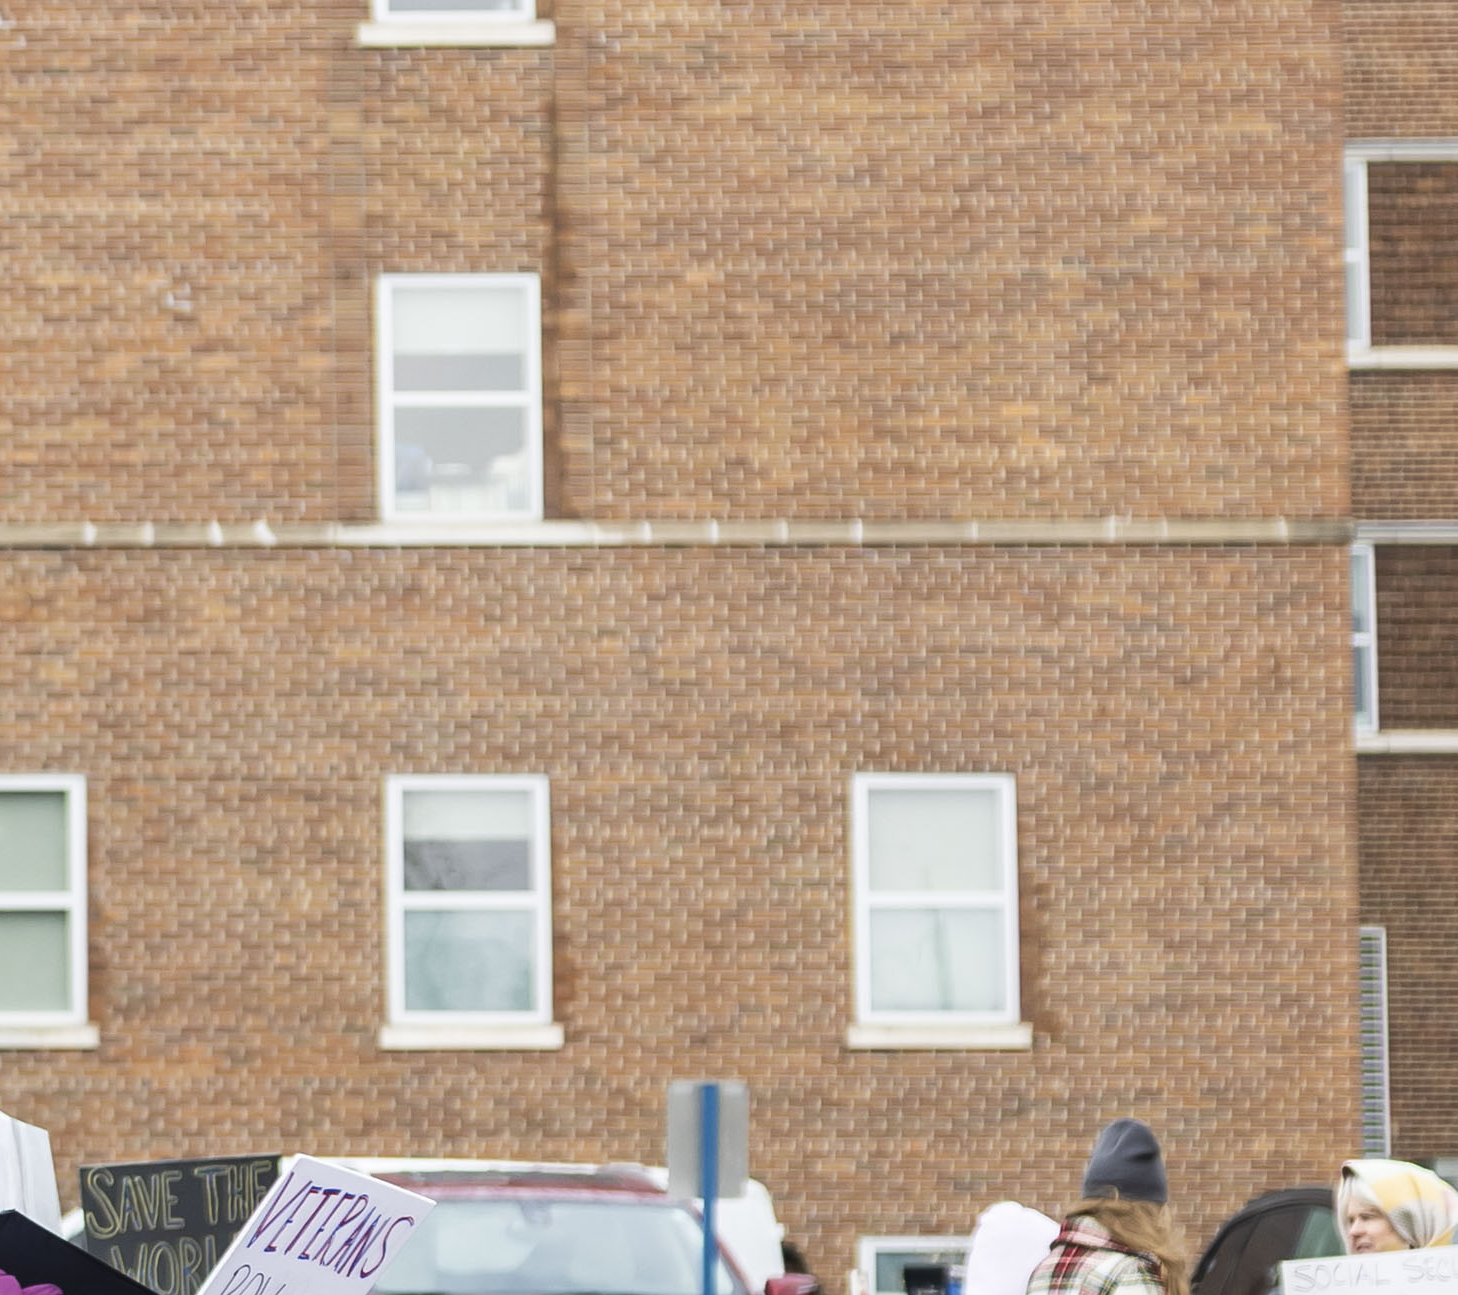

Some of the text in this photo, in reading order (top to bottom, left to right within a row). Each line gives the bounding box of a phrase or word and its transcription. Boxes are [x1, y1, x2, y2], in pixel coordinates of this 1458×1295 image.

[86, 1160, 273, 1239] SAVE THE
[246, 1171, 416, 1279] VETERANS
[1293, 1262, 1391, 1292] SOCIAL
